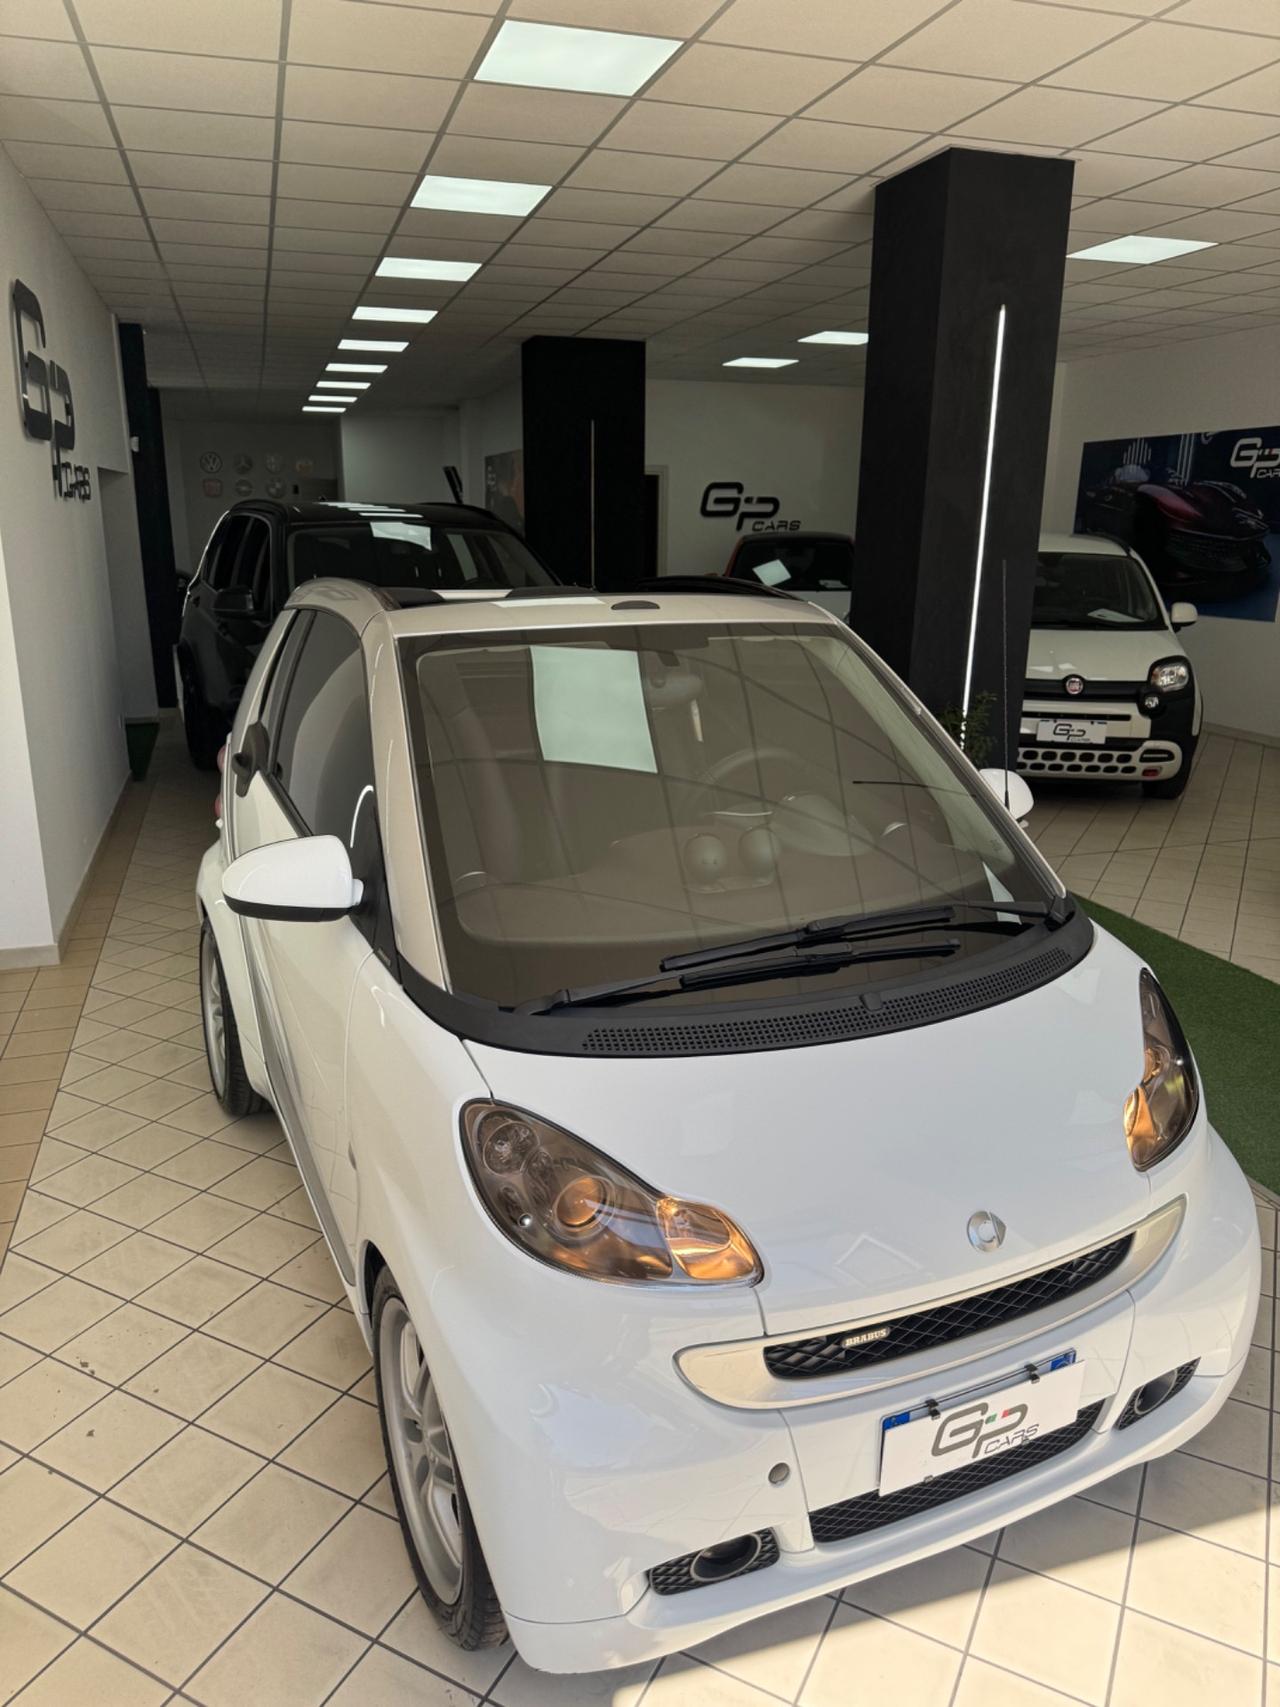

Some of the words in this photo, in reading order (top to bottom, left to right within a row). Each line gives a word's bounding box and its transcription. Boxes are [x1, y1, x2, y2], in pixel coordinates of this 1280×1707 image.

[13, 278, 76, 497] GP
[700, 482, 780, 532] GP
[752, 520, 801, 532] CARS
[1053, 723, 1086, 740] GP
[845, 1328, 887, 1346] BRABUS
[931, 1402, 1029, 1458] GP
[984, 1424, 1040, 1454] CARS
